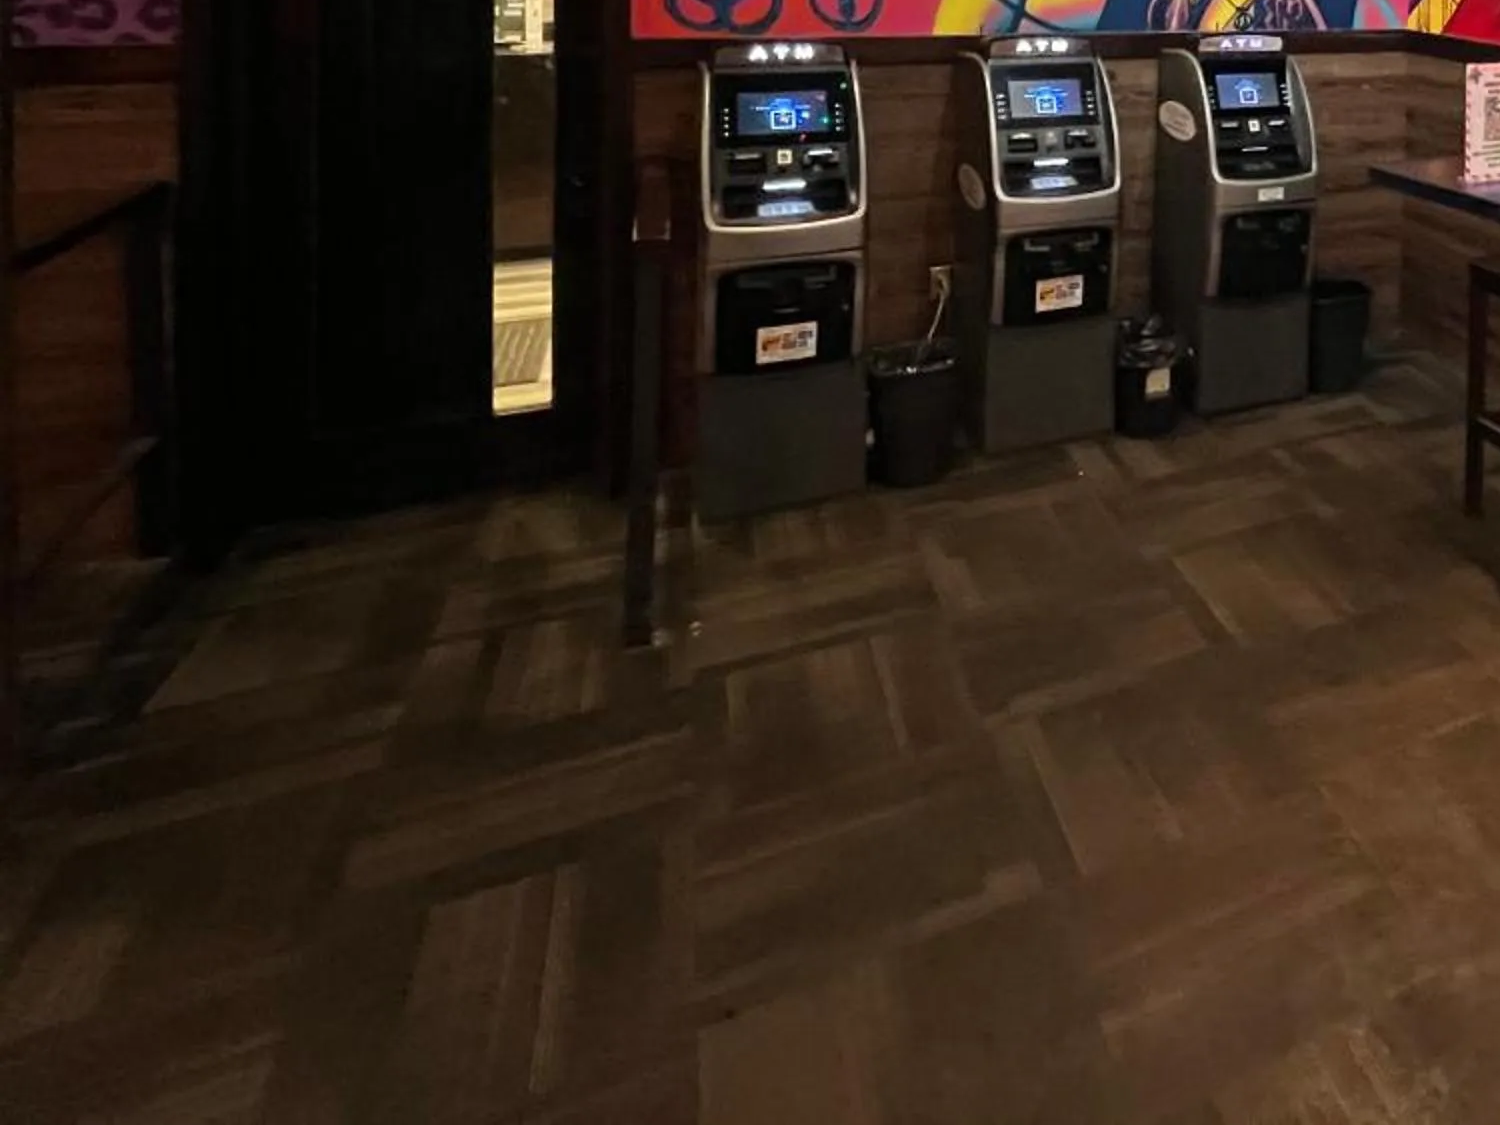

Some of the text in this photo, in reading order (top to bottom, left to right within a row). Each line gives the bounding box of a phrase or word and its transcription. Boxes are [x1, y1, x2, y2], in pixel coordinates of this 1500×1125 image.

[1015, 39, 1069, 53] ATM
[1220, 38, 1263, 49] ATM
[748, 43, 814, 62] ATM
